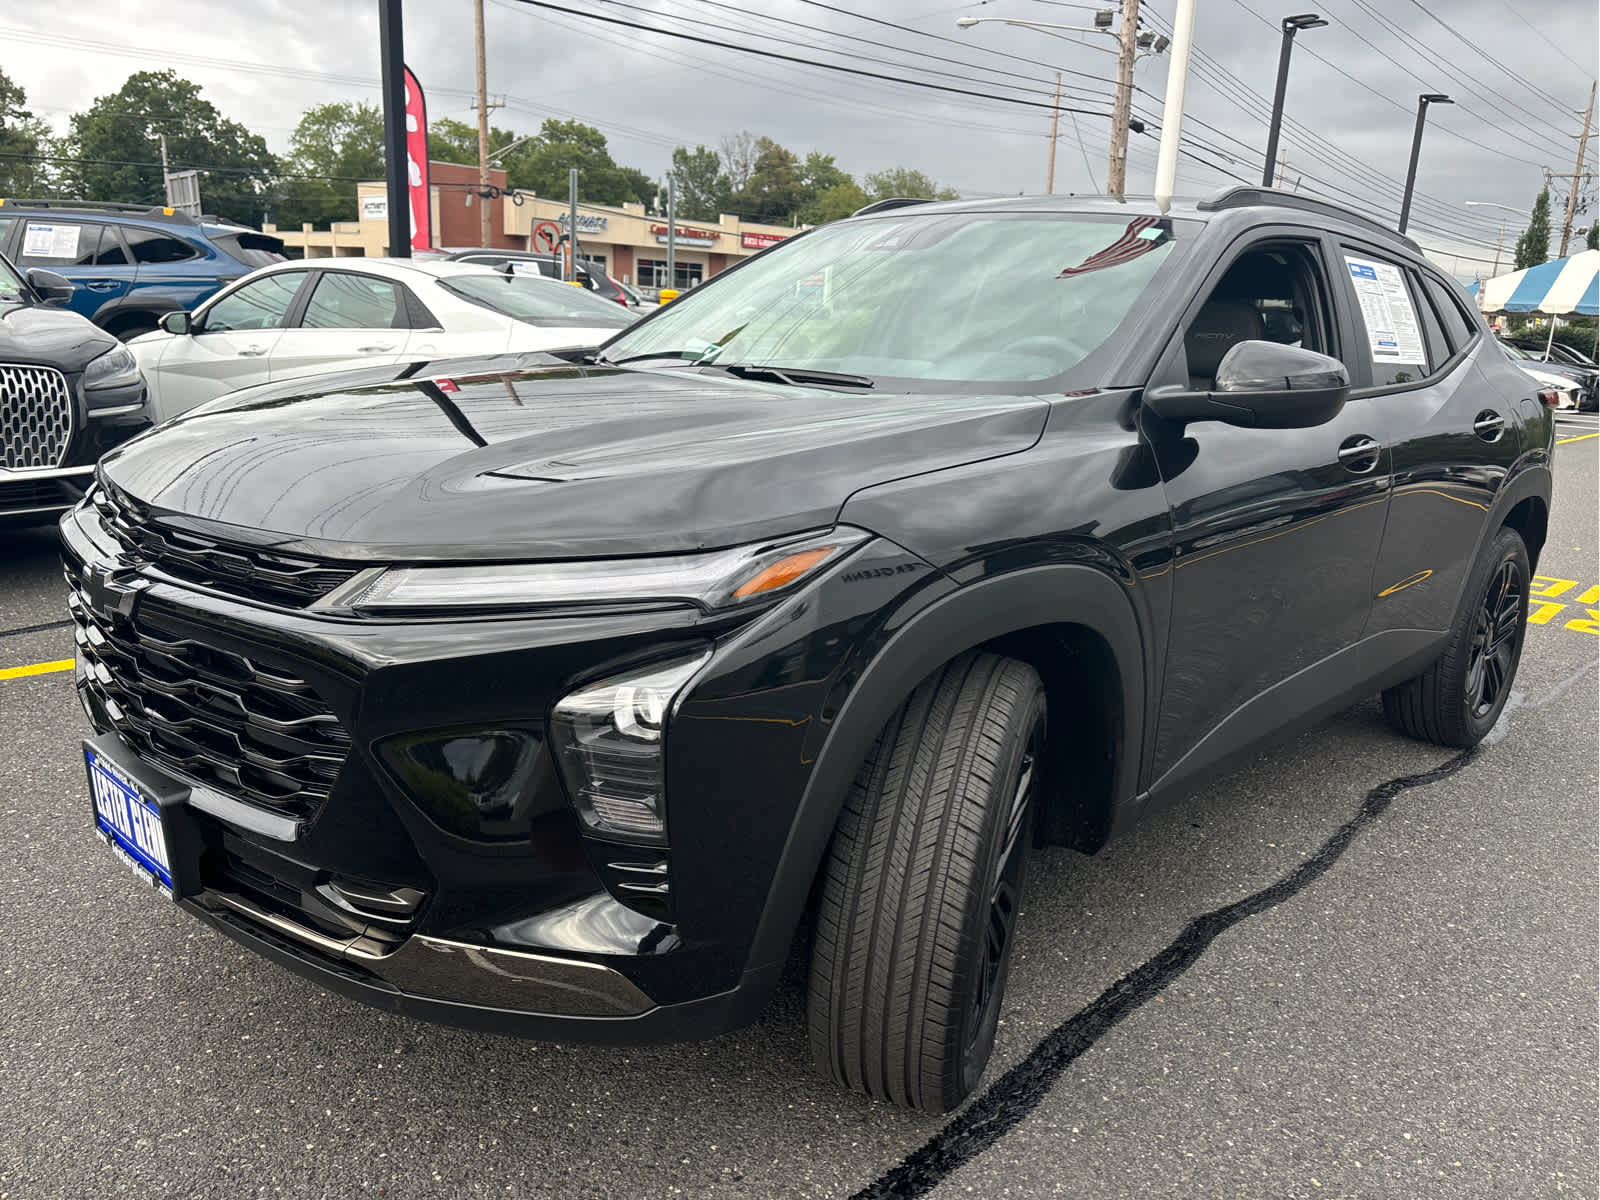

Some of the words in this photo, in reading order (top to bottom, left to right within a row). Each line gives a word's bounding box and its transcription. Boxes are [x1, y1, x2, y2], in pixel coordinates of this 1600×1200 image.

[559, 212, 608, 229] ACIVATE
[90, 765, 133, 840] LESTER
[129, 797, 170, 873] GLENN
